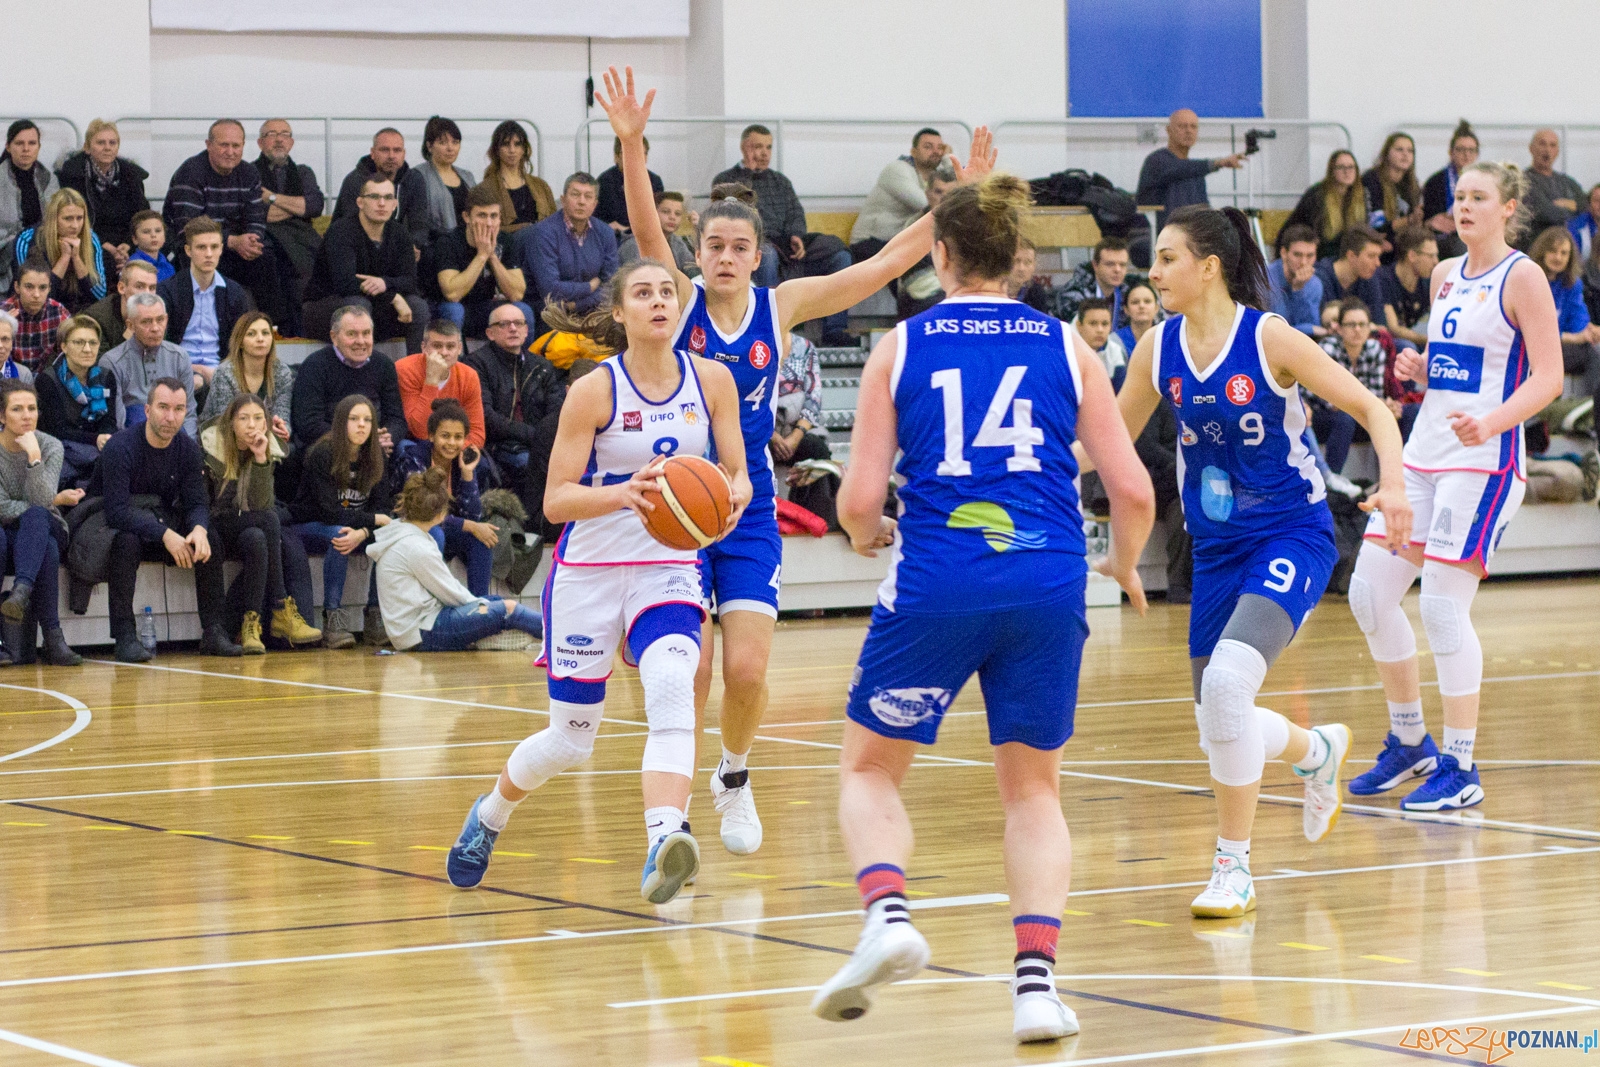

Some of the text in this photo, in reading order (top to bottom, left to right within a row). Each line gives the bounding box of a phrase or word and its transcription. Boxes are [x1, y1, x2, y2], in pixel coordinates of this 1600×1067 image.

[924, 317, 1050, 336] ŁKS SMS ŁÓDŹ
[1442, 307, 1462, 339] 6
[1429, 363, 1470, 381] Enea
[744, 376, 767, 411] 4
[931, 365, 1044, 477] 14
[1239, 412, 1265, 445] 9
[1263, 557, 1296, 593] 9
[556, 646, 575, 655] Bemo
[569, 636, 590, 646] Ford
